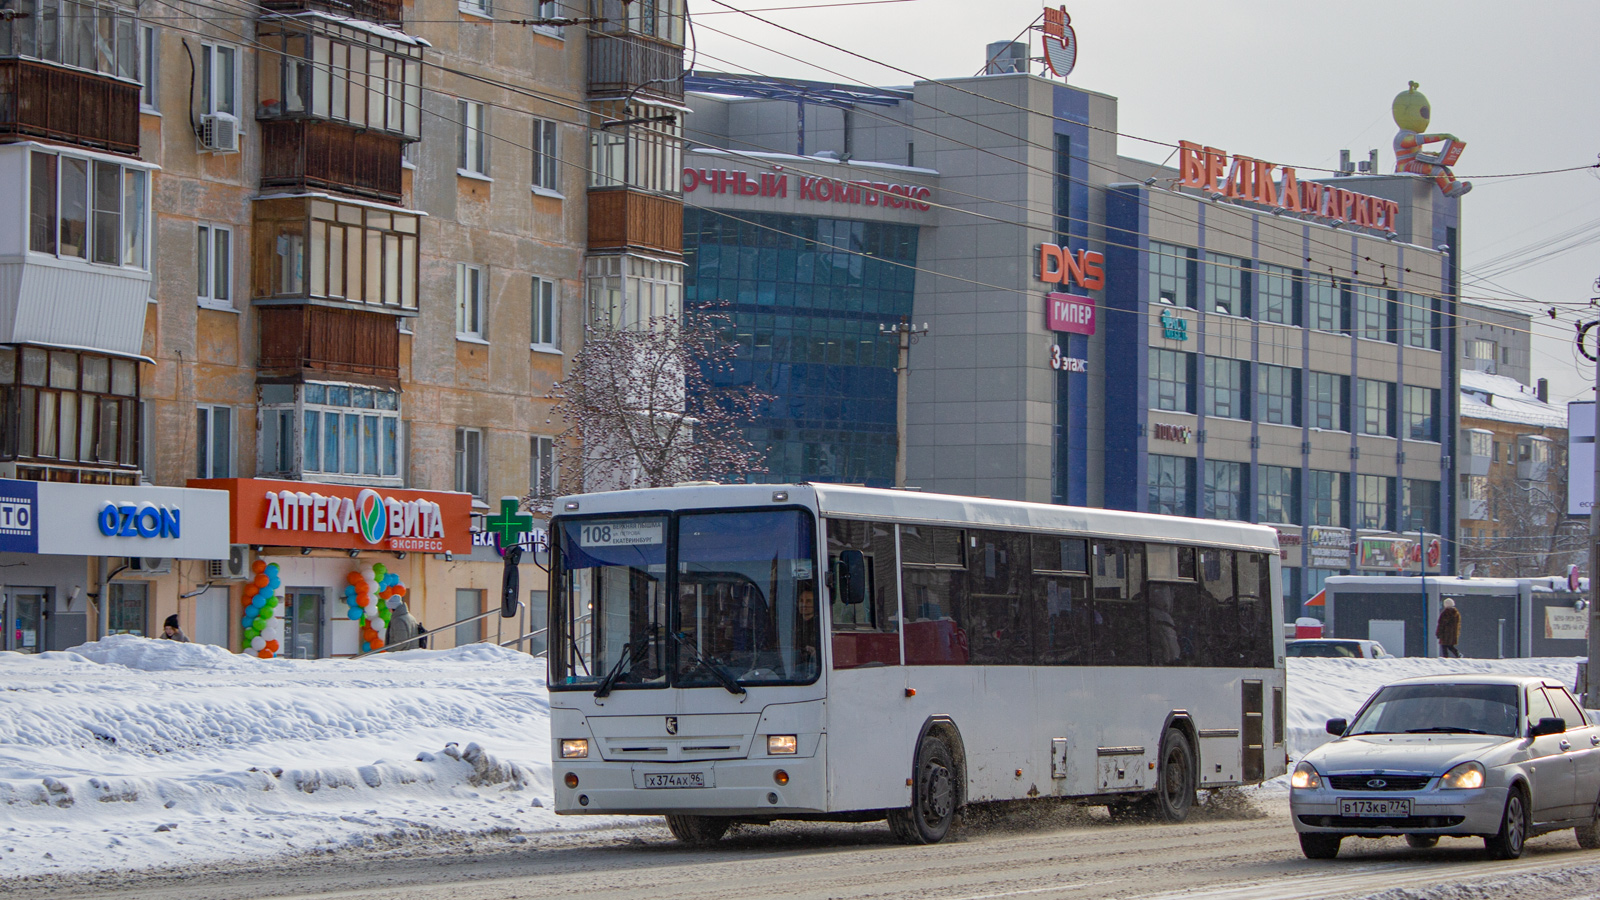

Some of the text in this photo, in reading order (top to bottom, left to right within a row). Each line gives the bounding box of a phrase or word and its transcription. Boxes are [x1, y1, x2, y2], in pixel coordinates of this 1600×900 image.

[800, 176, 931, 211] КОМПЛЕКС
[1179, 140, 1399, 232] БЕЛКА МАРКЕТ
[1040, 243, 1105, 291] DNS
[1054, 301, 1092, 325] ГИПЕР
[1051, 344, 1085, 373] 3 этаж
[98, 501, 181, 539] OZON
[265, 491, 446, 539] АПТЕКА ВИТА
[391, 538, 443, 551] ЭКСПРЕСС
[583, 526, 611, 543] 108
